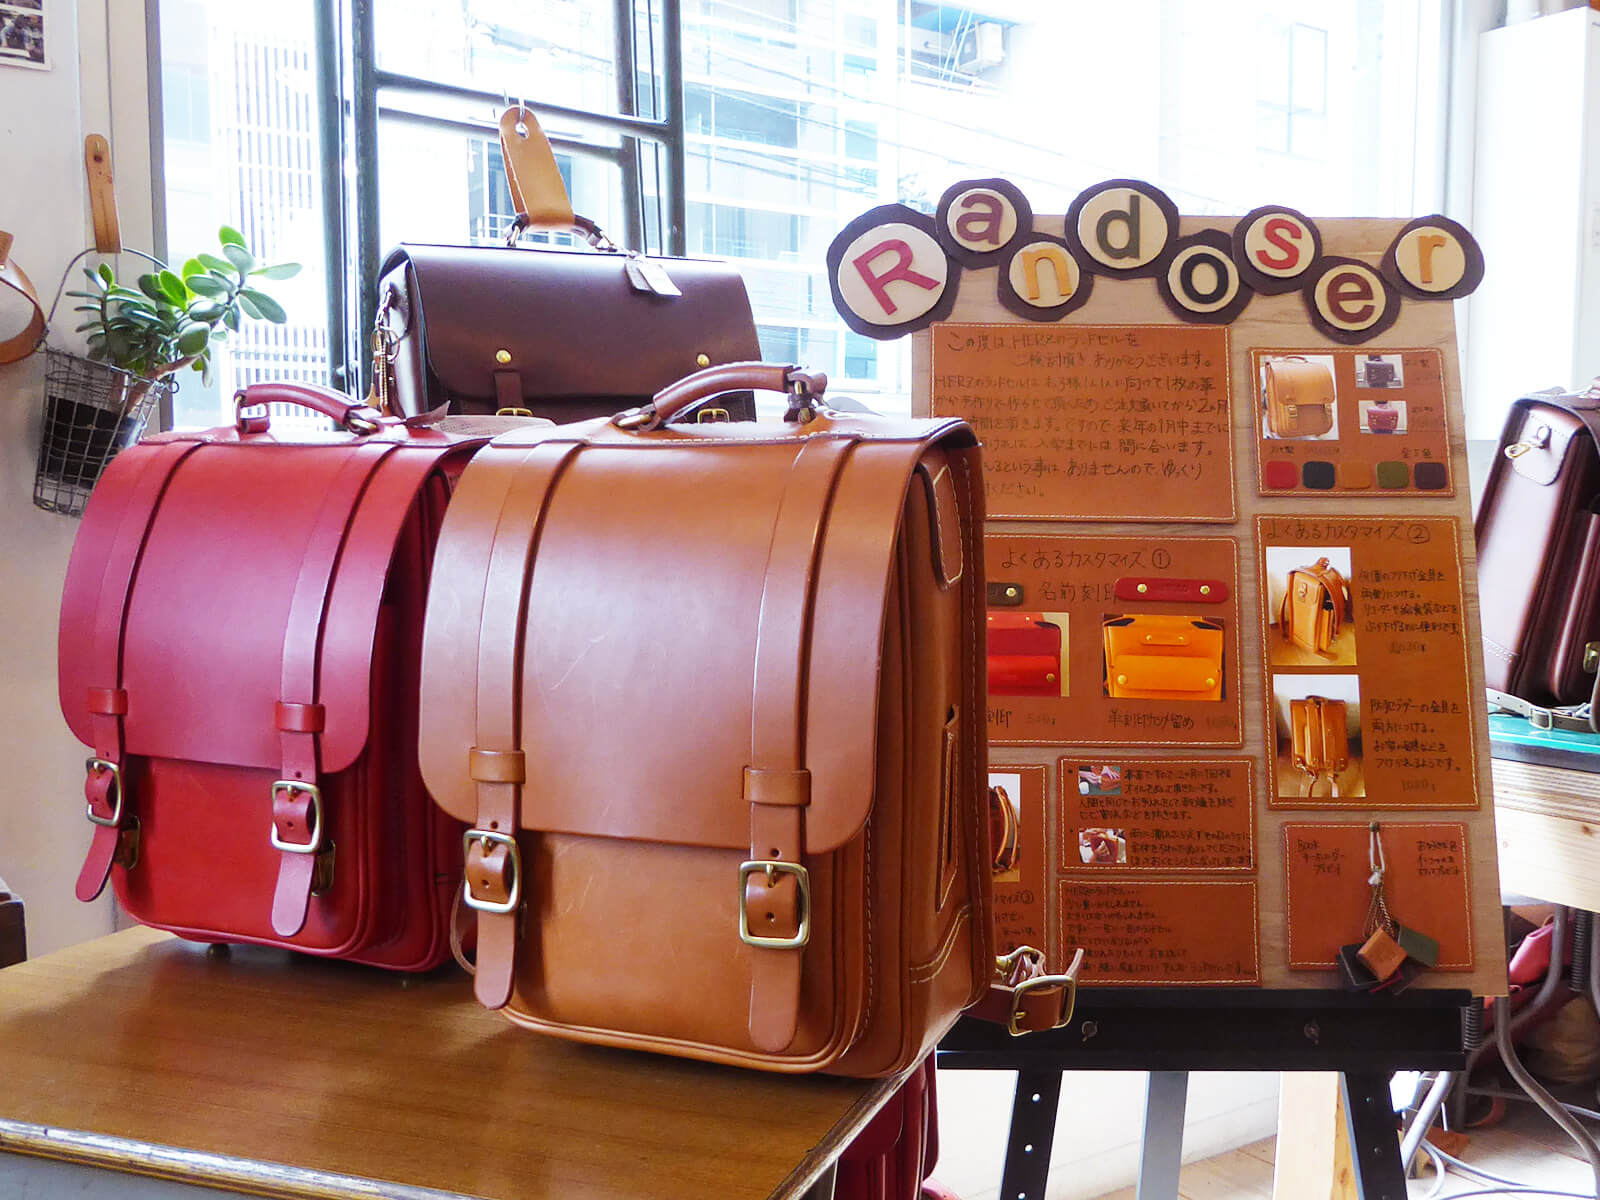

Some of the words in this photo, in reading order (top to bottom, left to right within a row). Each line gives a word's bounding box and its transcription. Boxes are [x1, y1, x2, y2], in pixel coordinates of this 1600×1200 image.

[853, 193, 1446, 324] Randoser
[1039, 581, 1117, 604] 名前刻印
